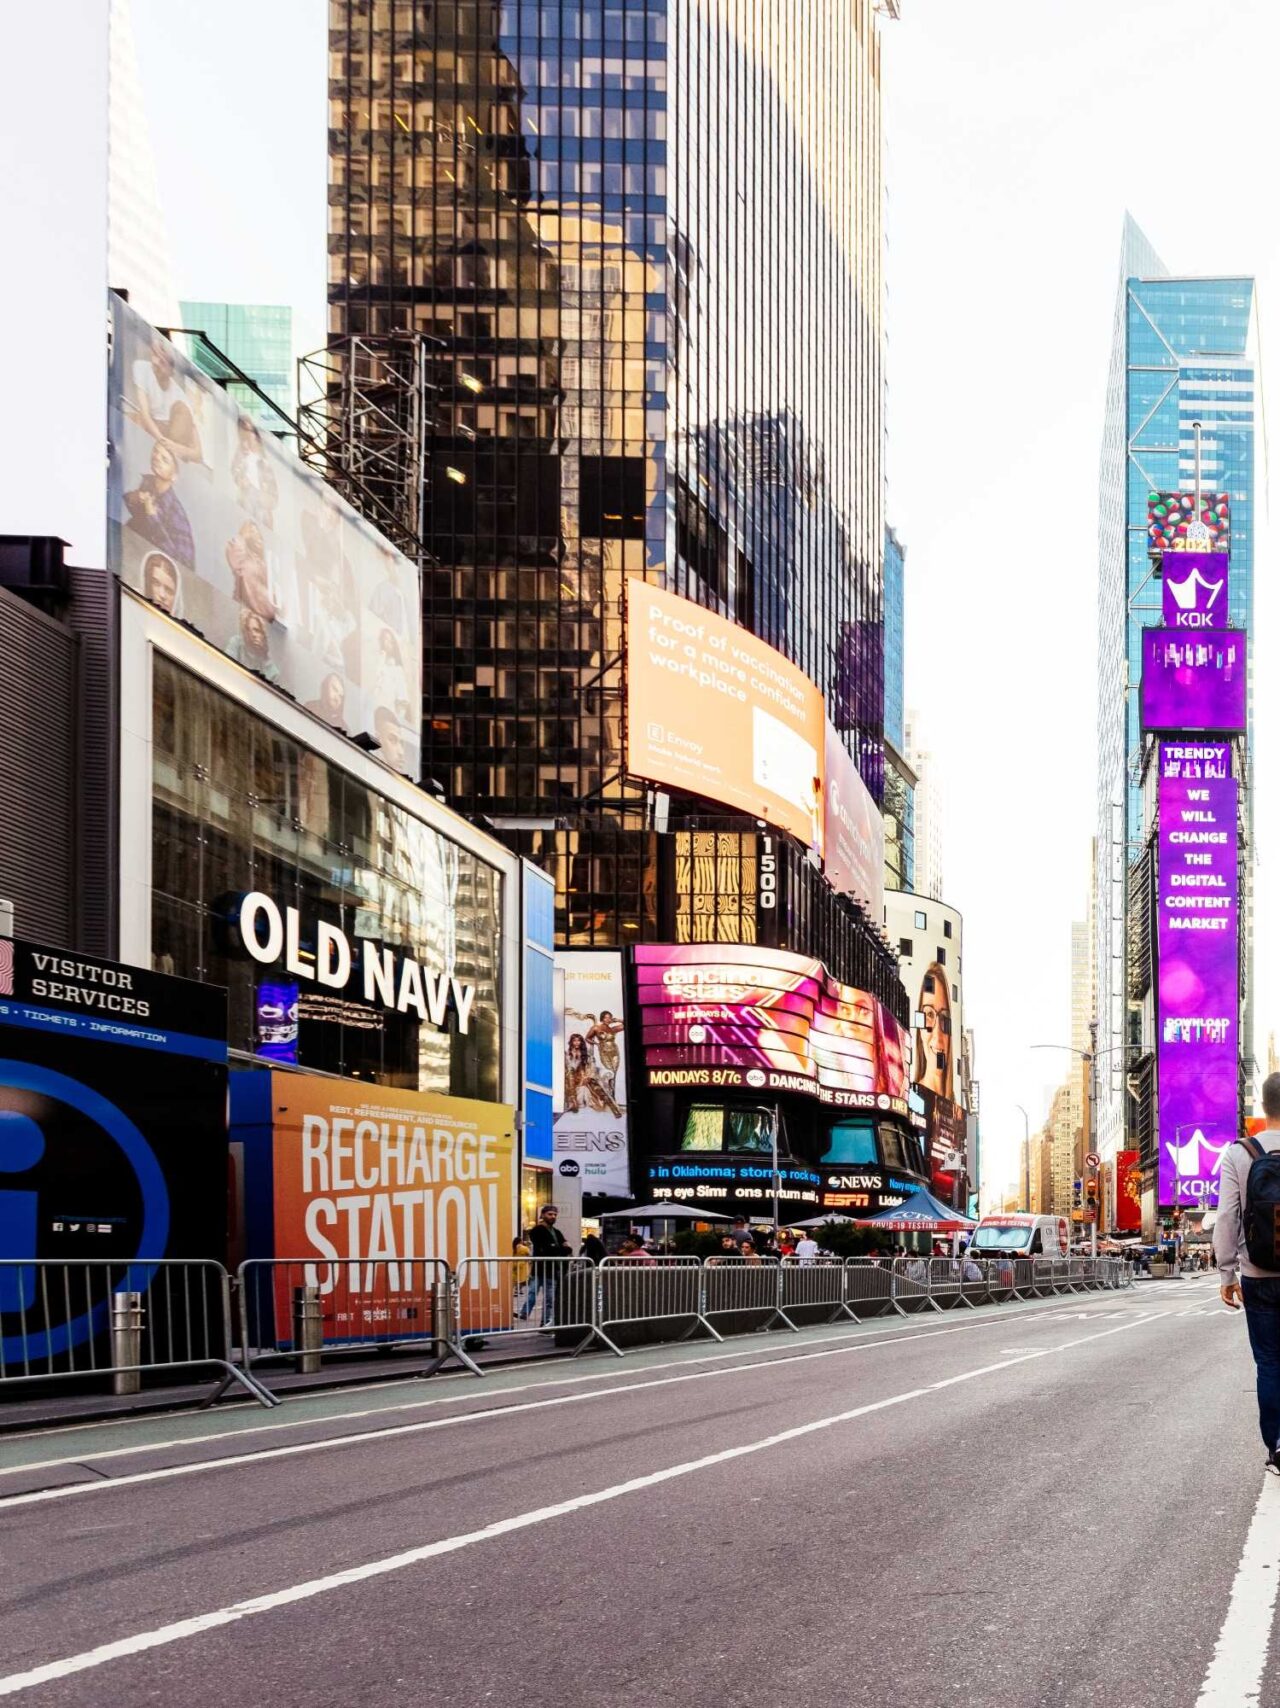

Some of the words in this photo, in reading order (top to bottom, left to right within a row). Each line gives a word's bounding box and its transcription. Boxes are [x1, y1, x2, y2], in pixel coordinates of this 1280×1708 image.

[1175, 612, 1214, 627] KOK
[649, 604, 705, 641] Proof
[708, 634, 729, 651] of
[731, 645, 806, 703] vaccination
[647, 625, 679, 651] for
[684, 644, 698, 659] a
[702, 651, 748, 683] more
[750, 675, 807, 722] confident
[649, 651, 748, 703] workplace
[1164, 747, 1225, 760] TRENDY
[1187, 789, 1210, 801] WE
[1181, 811, 1216, 822] WILL
[1169, 832, 1228, 844] CHANGE
[1184, 853, 1212, 865] THE
[760, 836, 776, 909] 1500
[1171, 875, 1226, 886] DIGITAL
[1165, 896, 1231, 908] CONTENT
[1169, 918, 1228, 930] MARKET
[240, 891, 351, 989] OLD
[363, 939, 476, 1036] NAVY
[31, 952, 134, 990] VISITOR
[31, 979, 151, 1017] SERVICES
[22, 1010, 77, 1027] TICKETS
[89, 1022, 167, 1043] INFORMATION
[650, 1071, 708, 1085] MONDAYS
[712, 1071, 741, 1085] 8/7c
[769, 1073, 817, 1093] DANCING
[835, 1094, 875, 1107] STARS
[302, 1113, 500, 1194] RECHARGE
[584, 1167, 607, 1175] hulu
[658, 1166, 669, 1178] in
[672, 1165, 736, 1179] Oklahoma;
[789, 1171, 809, 1180] rock
[840, 1175, 882, 1189] NEWS
[674, 1187, 694, 1199] eye
[824, 1193, 869, 1207] ESPN
[907, 1221, 938, 1230] TESTING
[304, 1184, 498, 1295] STATION
